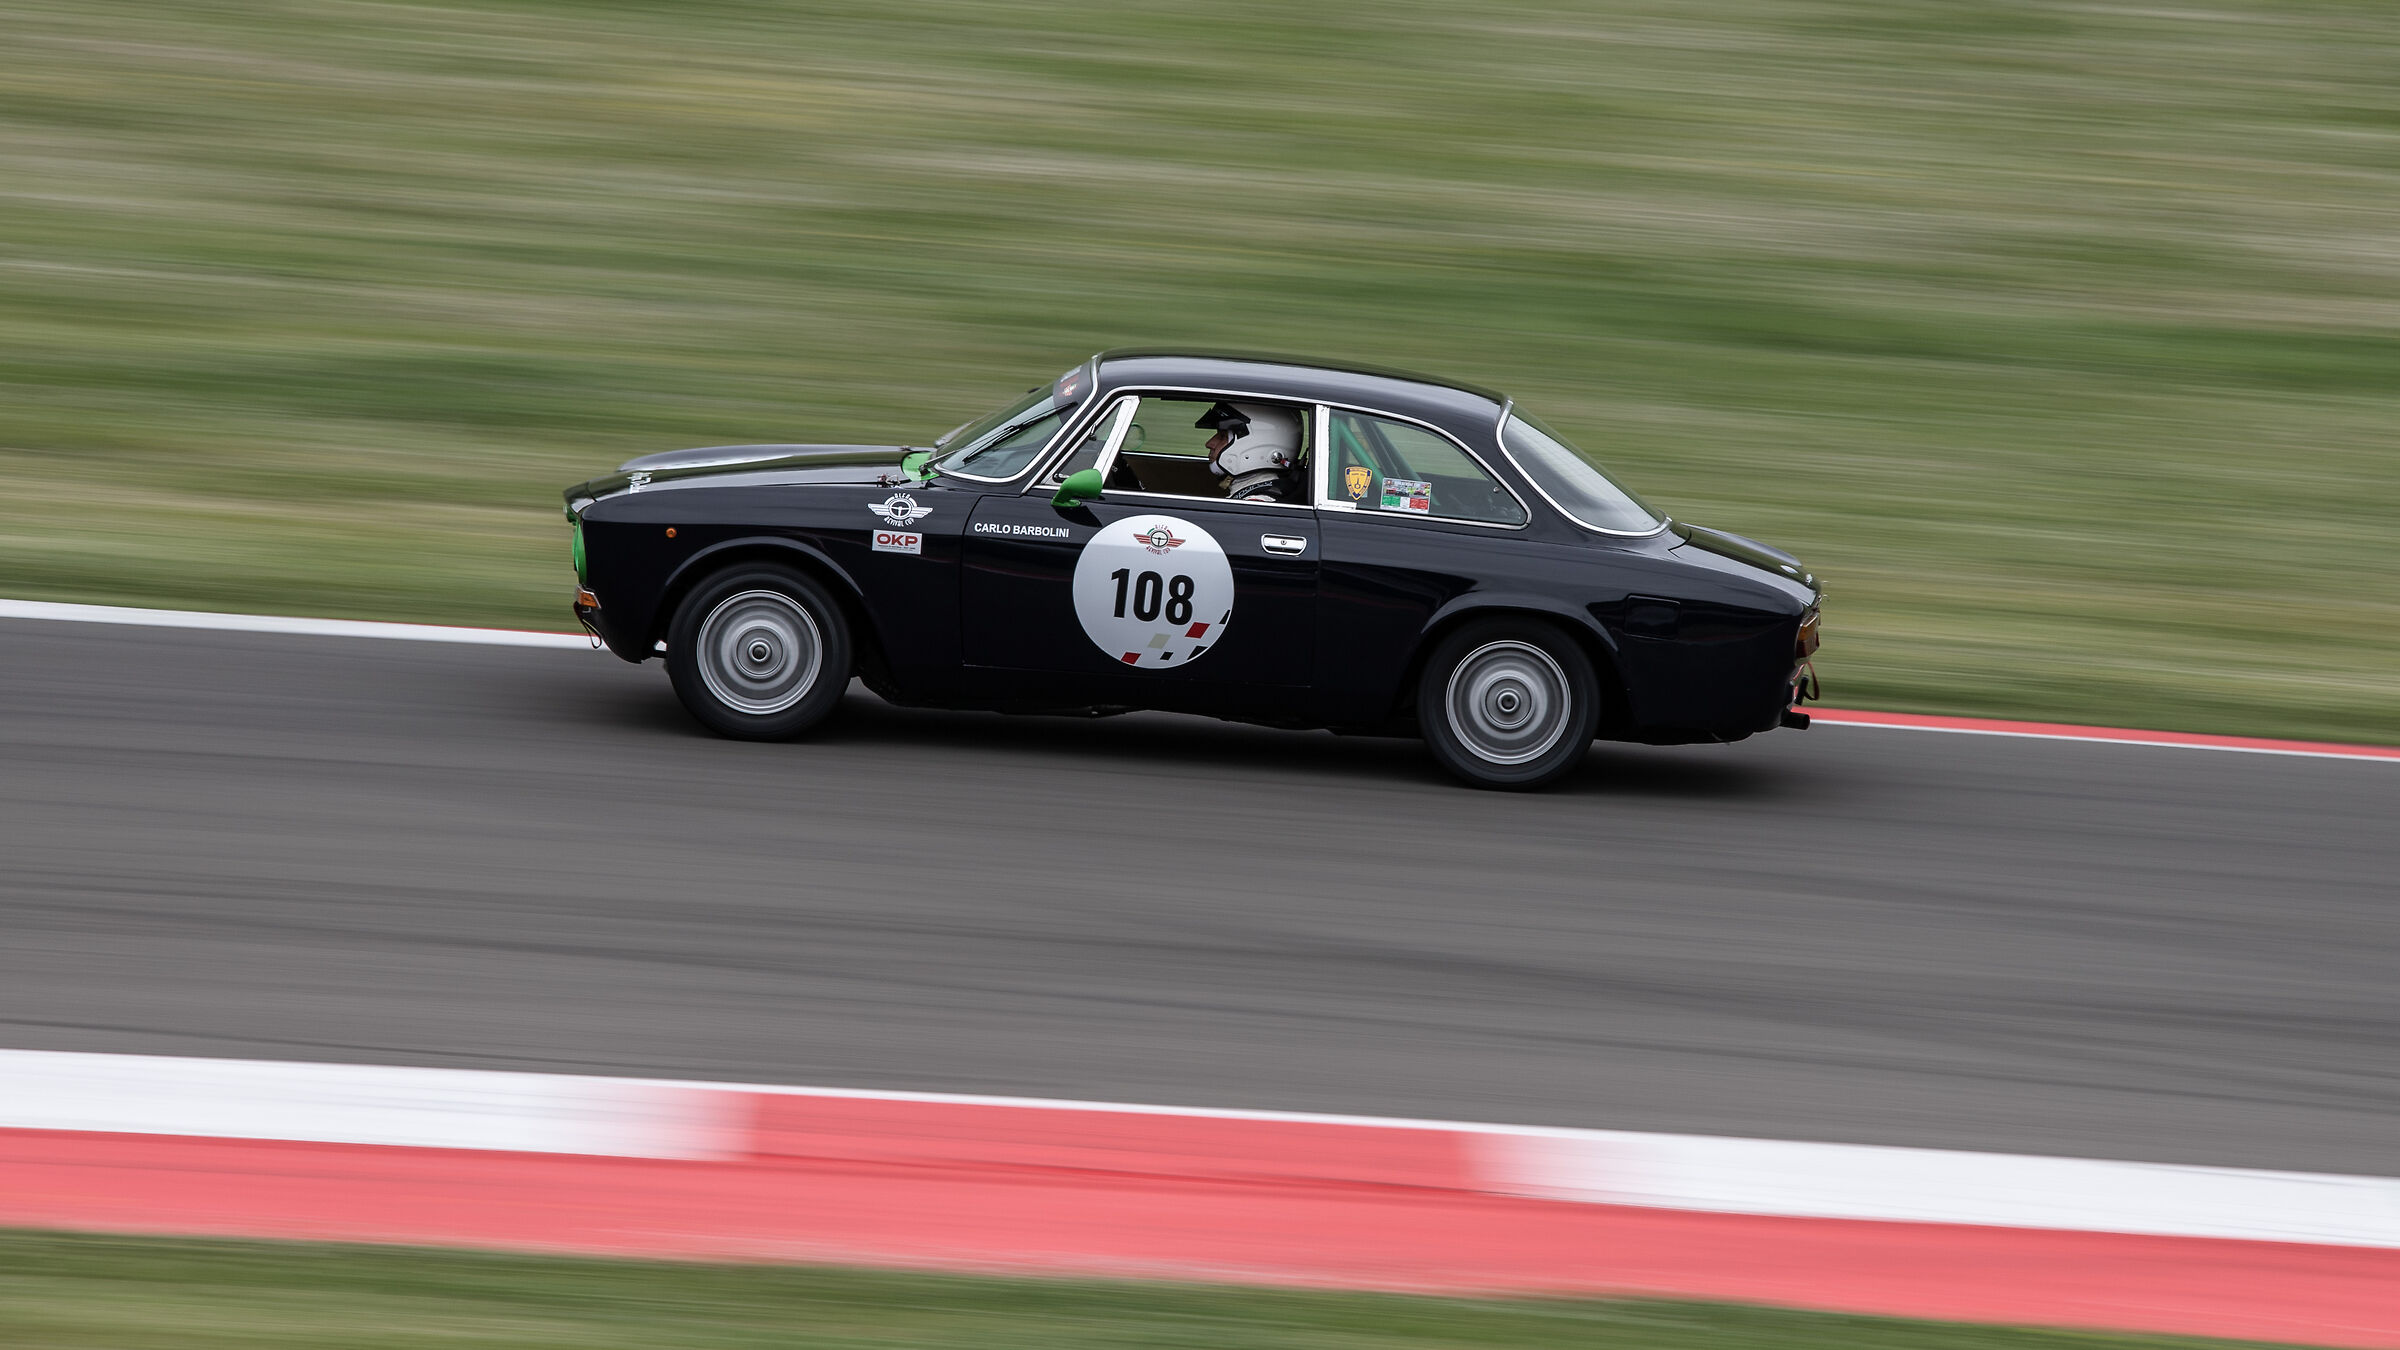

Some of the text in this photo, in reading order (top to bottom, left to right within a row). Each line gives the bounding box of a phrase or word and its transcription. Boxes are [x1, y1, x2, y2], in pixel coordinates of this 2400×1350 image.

[974, 523, 1070, 538] CARLO BARBOLINI
[876, 533, 918, 546] OKP
[1111, 568, 1195, 625] 108
